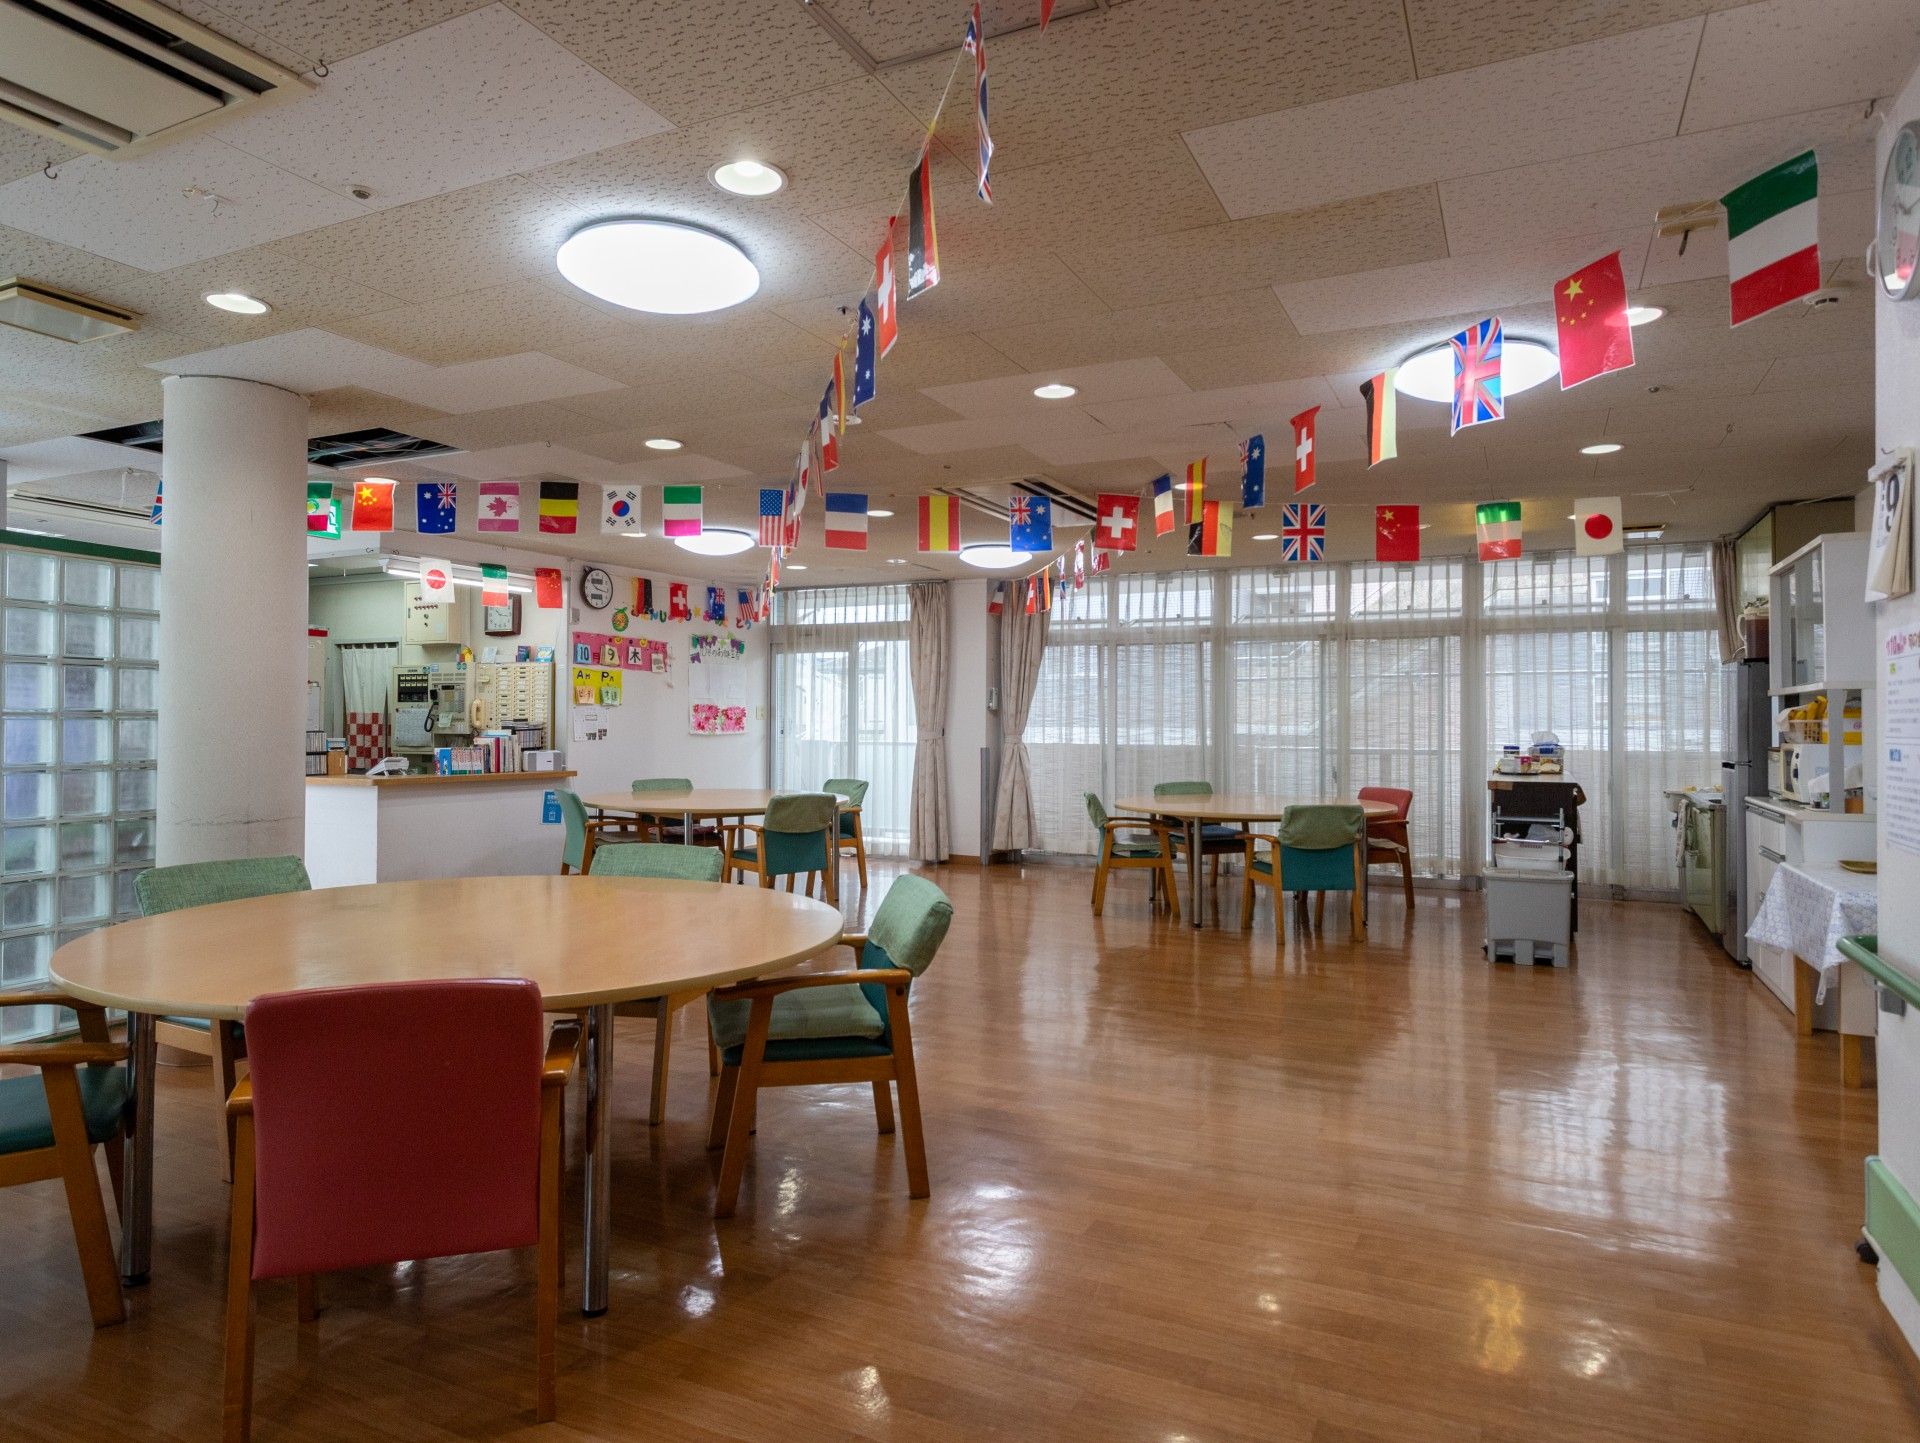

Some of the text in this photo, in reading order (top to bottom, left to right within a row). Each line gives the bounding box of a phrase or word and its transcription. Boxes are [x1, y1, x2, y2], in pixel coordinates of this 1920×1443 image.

[579, 646, 590, 661] 10
[607, 648, 615, 661] 9
[629, 648, 641, 664] 木
